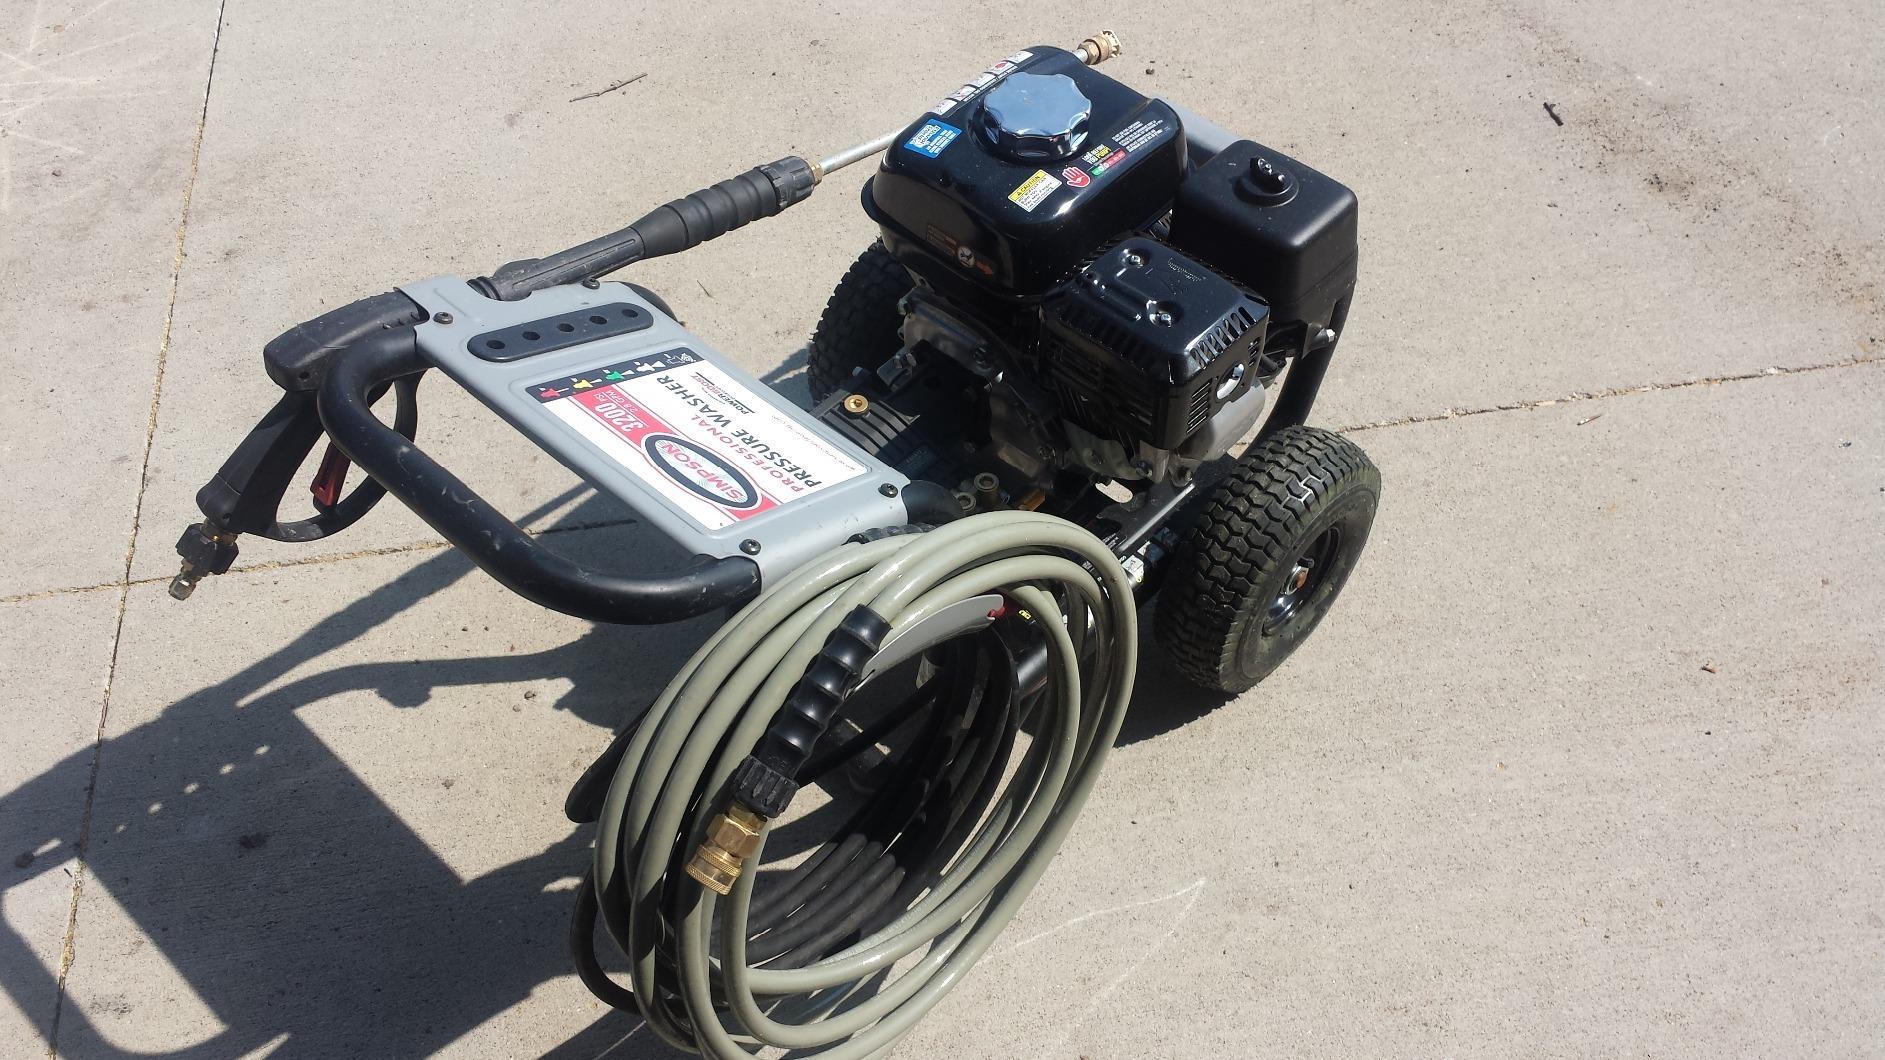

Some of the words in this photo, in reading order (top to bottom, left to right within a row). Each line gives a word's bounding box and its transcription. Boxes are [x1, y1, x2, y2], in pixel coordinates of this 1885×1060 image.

[594, 402, 644, 432] 3200
[656, 375, 736, 428] WASHER
[660, 441, 745, 500] SIMPSON
[698, 414, 804, 493] PROFESSIONAL
[735, 428, 823, 488] PRESSURE
